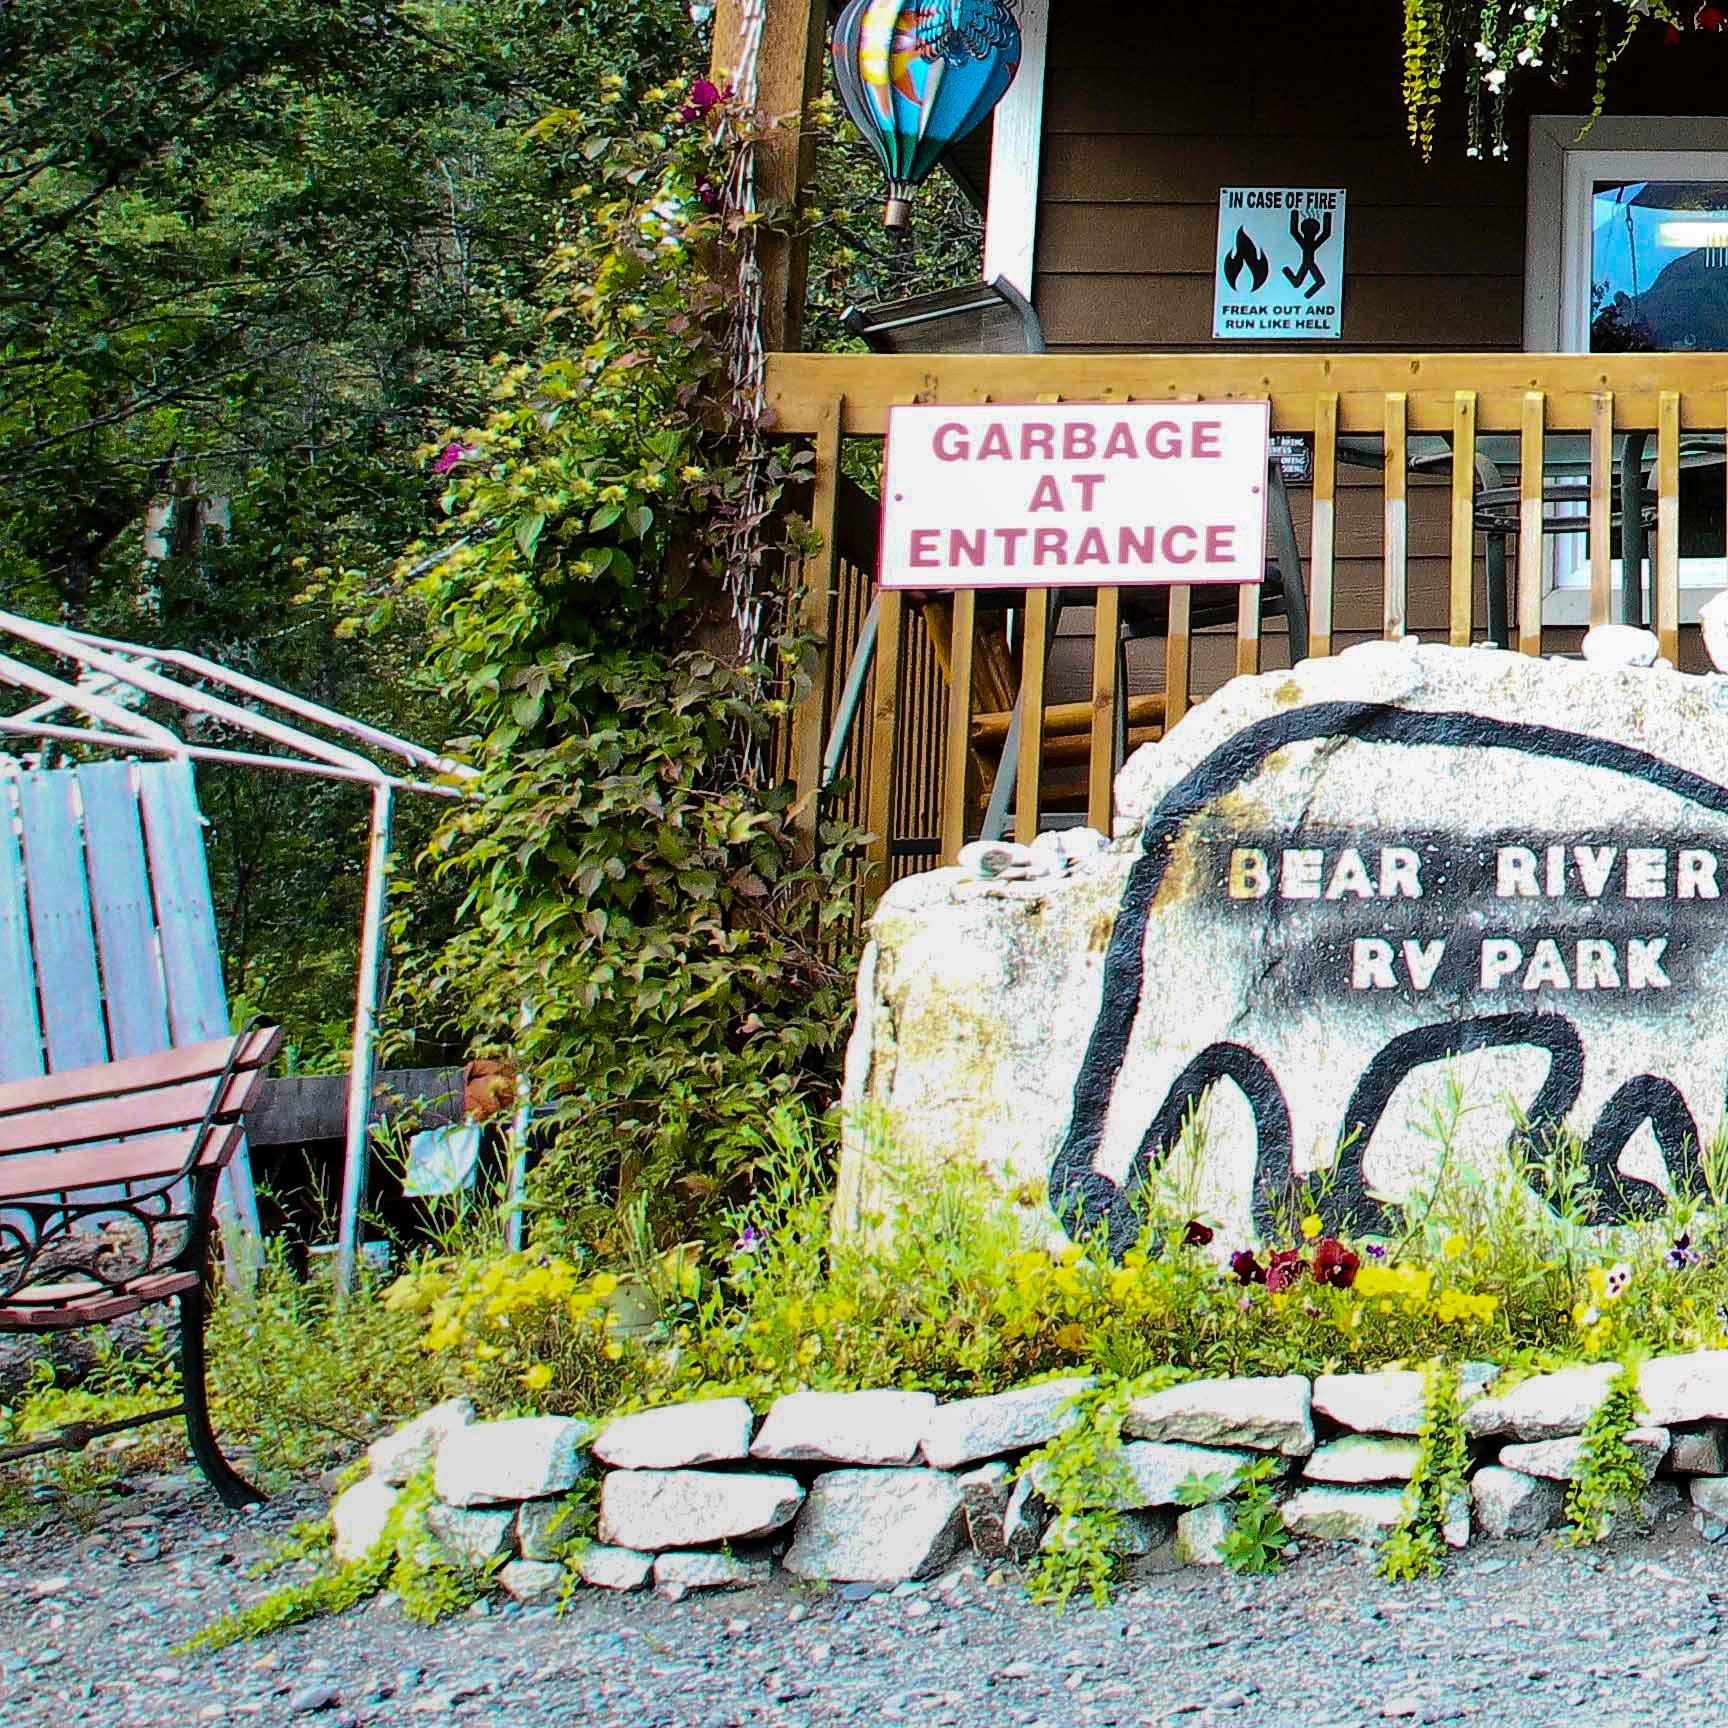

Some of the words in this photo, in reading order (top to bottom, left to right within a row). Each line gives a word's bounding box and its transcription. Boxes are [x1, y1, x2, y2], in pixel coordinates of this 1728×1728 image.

[1229, 191, 1243, 209] IN
[1247, 191, 1283, 209] CASE
[1285, 191, 1303, 209] OF
[1306, 192, 1337, 210] FIRE
[1222, 305, 1268, 315] FREAK
[1272, 305, 1302, 315] OUT
[1305, 305, 1336, 316] AND
[1225, 320, 1255, 329] RUN
[1259, 319, 1292, 330] LIKE
[1295, 319, 1331, 330] HELL
[932, 421, 1222, 462] GARBAGE
[1029, 475, 1105, 512] AT
[909, 525, 1235, 568] ENTRANCE
[1227, 846, 1423, 900] BEAR
[1496, 845, 1720, 900] RIVER
[1351, 937, 1446, 990] RV
[1480, 937, 1671, 990] PARK
